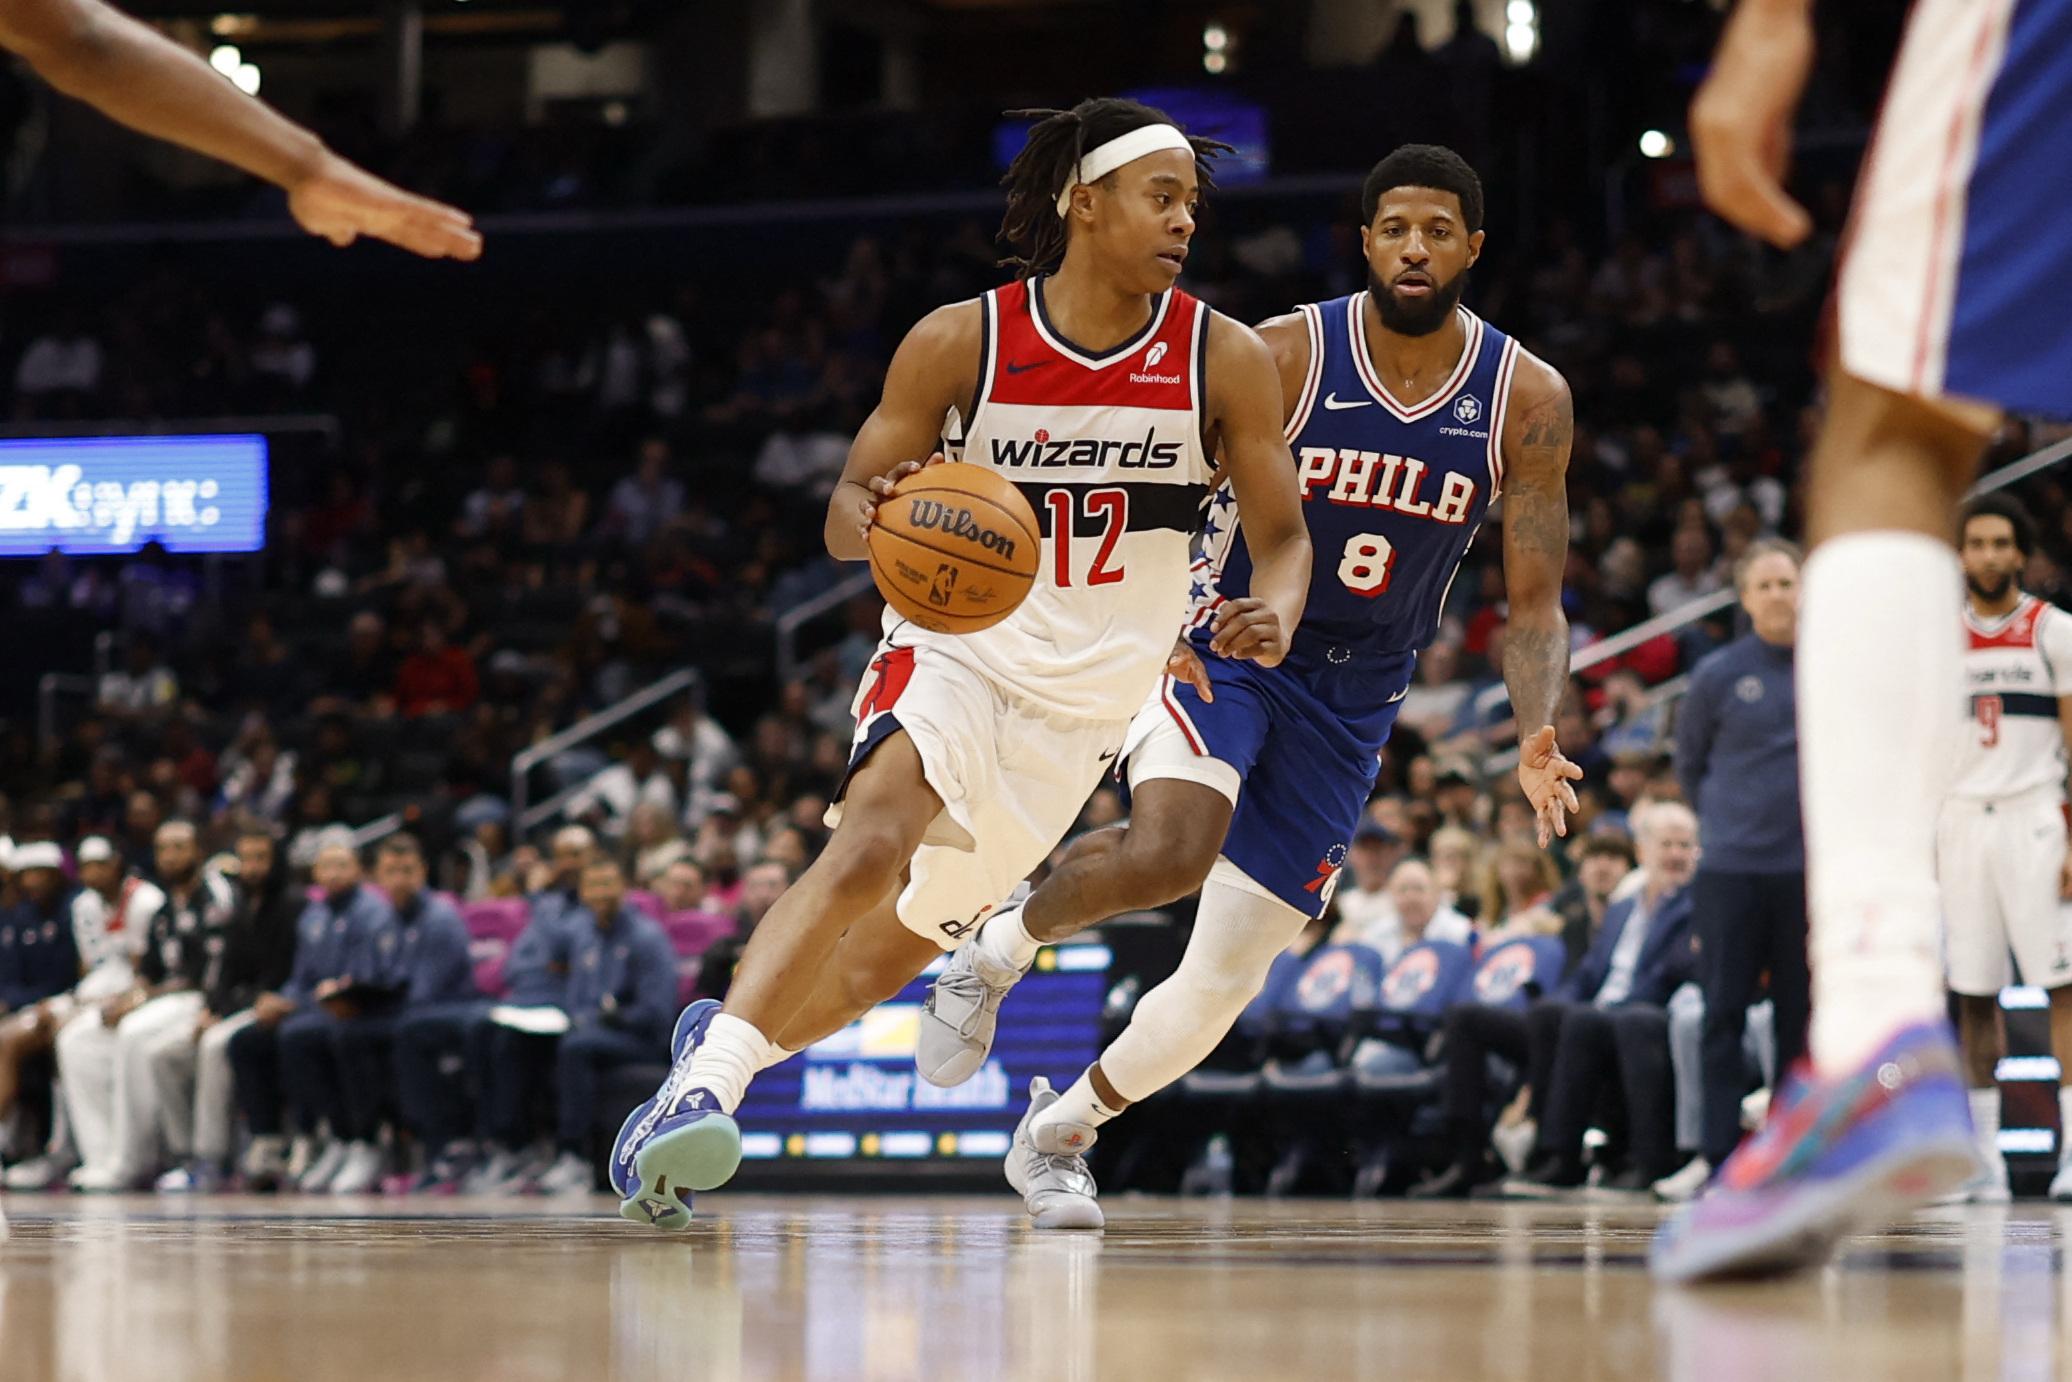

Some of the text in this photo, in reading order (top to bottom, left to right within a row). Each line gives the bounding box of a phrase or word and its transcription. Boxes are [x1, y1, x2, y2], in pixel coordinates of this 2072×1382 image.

[1129, 373, 1180, 384] Robinhood
[991, 426, 1184, 469] wizards
[1439, 426, 1489, 439] crypto.com
[1298, 447, 1478, 525] PHILA
[909, 499, 1016, 561] Wilson
[1044, 487, 1128, 591] 12
[1337, 532, 1397, 598] 8
[1976, 695, 2003, 747] 9
